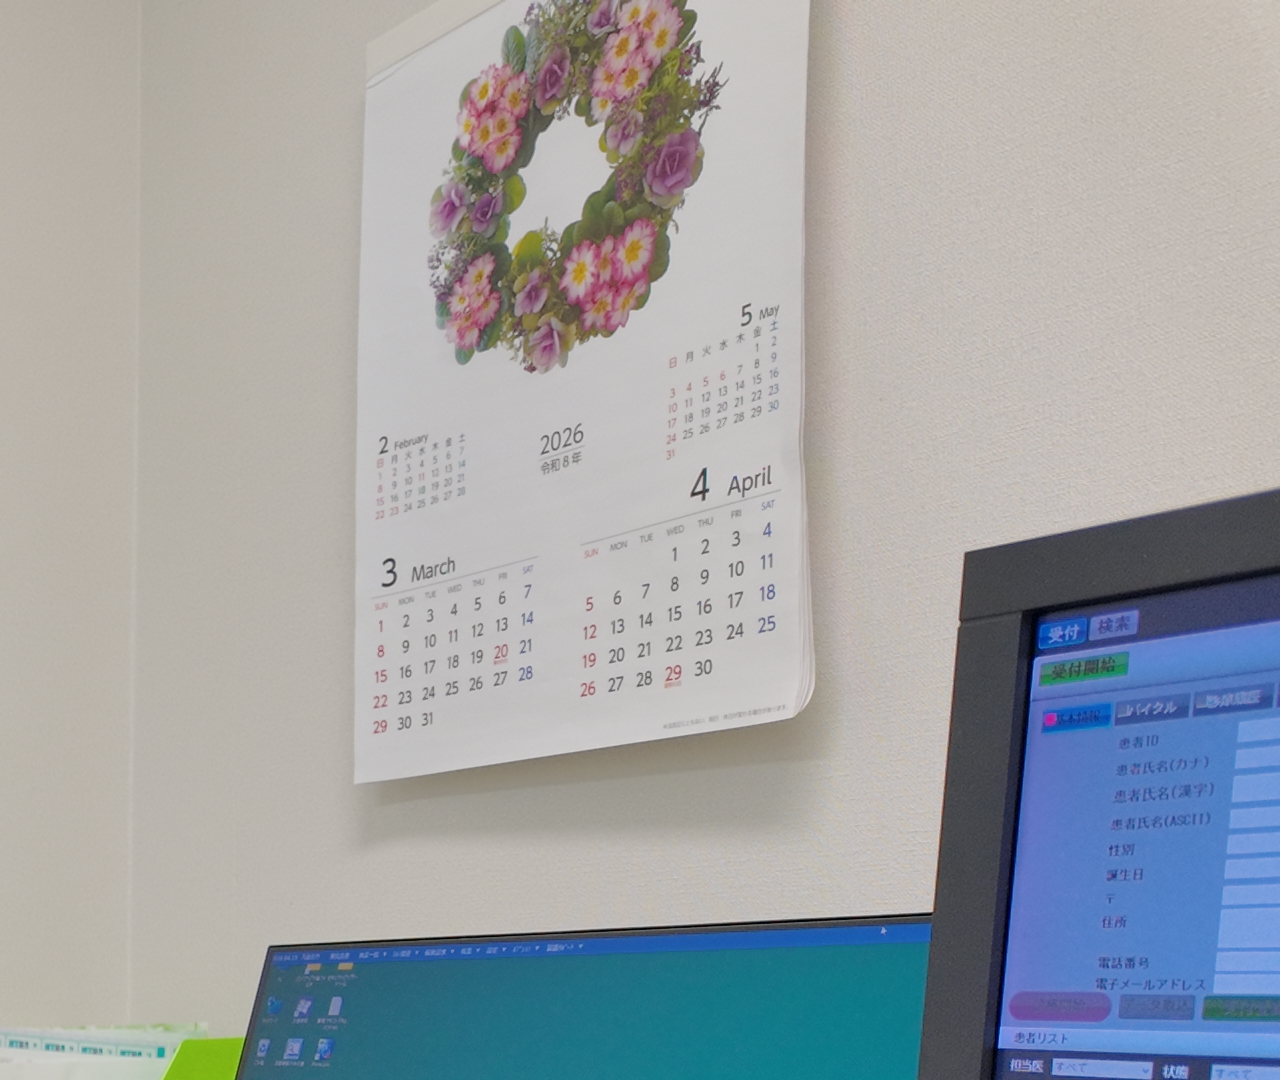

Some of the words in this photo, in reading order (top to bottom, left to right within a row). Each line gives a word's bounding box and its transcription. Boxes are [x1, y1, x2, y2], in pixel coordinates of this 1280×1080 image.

[741, 303, 753, 327] 5
[759, 304, 781, 321] May
[379, 436, 389, 455] 2
[394, 433, 429, 452] February
[541, 423, 585, 456] 2026
[541, 451, 583, 476] 令和8年
[690, 468, 709, 501] 4
[727, 465, 772, 498] April
[584, 548, 598, 558] SUN
[610, 541, 627, 551] MON
[640, 533, 653, 543] TUE
[666, 525, 684, 536] WED
[698, 517, 713, 527] THU
[731, 509, 741, 519] FRI
[762, 500, 775, 511] SAT
[672, 547, 677, 561] 1
[701, 539, 709, 554] 2
[732, 531, 740, 547] 3
[763, 522, 772, 537] 4
[381, 557, 397, 588] 3
[411, 557, 456, 582] March
[586, 597, 593, 611] 5
[613, 590, 621, 605] 6
[642, 583, 650, 599] 7
[671, 576, 679, 591] 8
[701, 569, 709, 585] 9
[729, 561, 744, 577] 10
[761, 553, 773, 570] 11
[379, 620, 383, 632] 1
[403, 614, 409, 628] 2
[427, 609, 434, 622] 3
[451, 603, 457, 615] 4
[475, 597, 481, 611] 5
[499, 591, 506, 605] 6
[525, 584, 531, 598] 7
[583, 624, 596, 640] 12
[611, 618, 624, 634] 13
[639, 612, 653, 628] 14
[668, 605, 682, 622] 15
[697, 598, 712, 615] 16
[728, 591, 743, 608] 17
[760, 584, 775, 601] 18
[377, 645, 384, 658] 8
[402, 640, 409, 653] 9
[425, 634, 436, 648] 10
[449, 629, 458, 643] 11
[472, 623, 483, 637] 12
[496, 617, 508, 632] 13
[522, 611, 533, 626] 14
[583, 653, 596, 668] 19
[609, 647, 625, 664] 20
[638, 642, 650, 658] 21
[666, 635, 682, 652] 22
[696, 629, 713, 646] 23
[727, 623, 744, 640] 24
[758, 615, 776, 633] 25
[1048, 623, 1080, 645] 受付
[1098, 615, 1131, 635] 検索
[375, 669, 387, 683] 15
[400, 665, 412, 678] 16
[424, 660, 436, 674] 17
[448, 655, 459, 669] 18
[471, 650, 483, 664] 19
[495, 644, 508, 659] 20
[520, 639, 531, 654] 21
[1051, 657, 1116, 681] 受付開始
[373, 694, 387, 709] 22
[398, 690, 412, 705] 23
[422, 686, 435, 700] 24
[446, 681, 459, 696] 25
[469, 676, 483, 691] 26
[494, 671, 507, 686] 27
[519, 666, 533, 681] 28
[581, 681, 596, 697] 26
[608, 676, 624, 692] 27
[637, 671, 652, 687] 28
[665, 665, 682, 682] 29
[695, 659, 712, 676] 30
[373, 720, 387, 734] 29
[398, 716, 411, 730] 30
[422, 712, 433, 726] 31
[1119, 735, 1160, 750] 患者ID
[1116, 756, 1210, 776] 患者氏名(カナ)
[1108, 843, 1135, 857] 性別
[1106, 868, 1144, 882] 誕生日
[1102, 915, 1127, 929] 住所
[1098, 956, 1150, 970] 電話番号
[1095, 977, 1206, 991] 電子メールアドレス
[1014, 1032, 1069, 1045] 患者リスト
[1055, 1062, 1088, 1073] すべて
[1215, 1068, 1252, 1080] すべて
